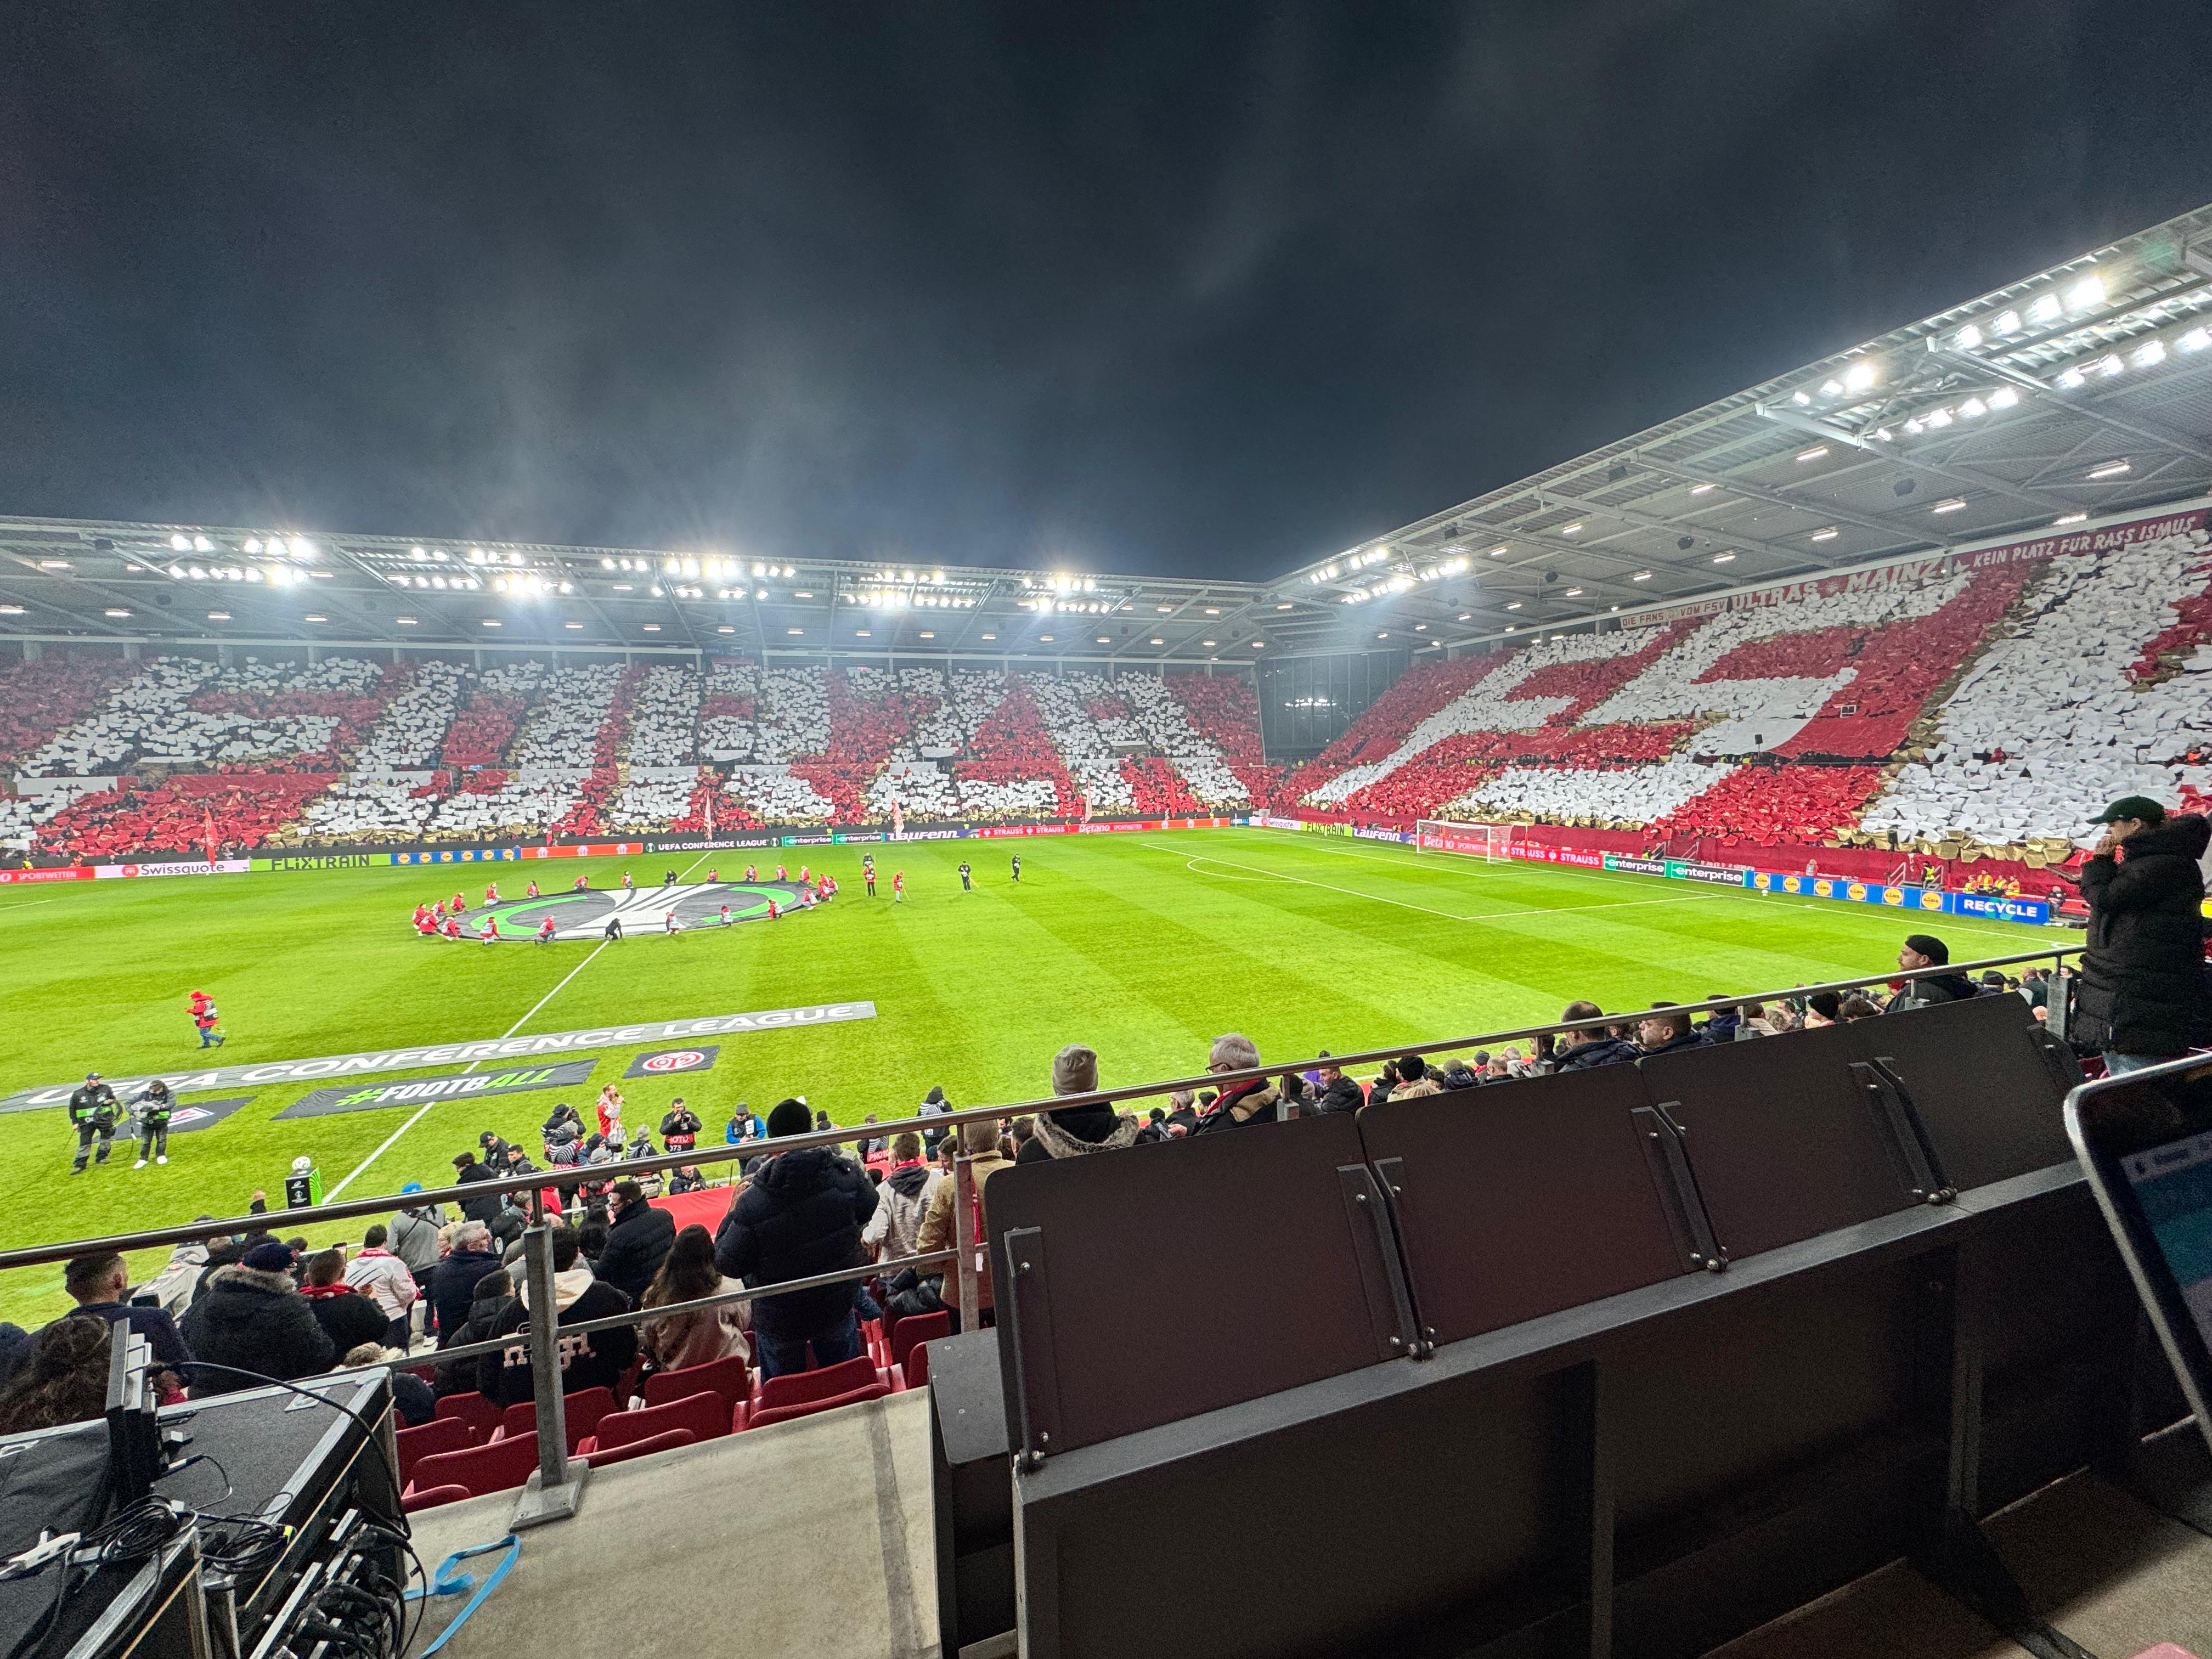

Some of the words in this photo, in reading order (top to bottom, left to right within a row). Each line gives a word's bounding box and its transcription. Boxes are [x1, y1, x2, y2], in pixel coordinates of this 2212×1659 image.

[1974, 550, 2007, 568] KEIN
[2012, 541, 2053, 561] PLATZ
[1731, 582, 1818, 610] ULTRAS
[1844, 557, 1943, 592] MAINZ
[1622, 617, 1636, 627] DIE
[1639, 610, 1664, 624] FANS
[1680, 606, 1700, 617] VOM
[1703, 600, 1726, 613] FSV
[682, 840, 735, 849] CONFERENCE
[786, 836, 832, 845] enterprise
[837, 834, 881, 843] enterprise
[1510, 845, 1545, 859] STRAUSS
[1560, 852, 1600, 866] STRAUSS
[141, 862, 225, 876] Swissquote
[1606, 857, 1665, 873] enterprise
[18, 871, 77, 881] SPORTWETTEN
[1673, 865, 1743, 883] enterprise
[1964, 899, 2037, 917] RECYCLE
[241, 1026, 646, 1081] CONFERENCE
[335, 1068, 555, 1107] #FOOTBALL
